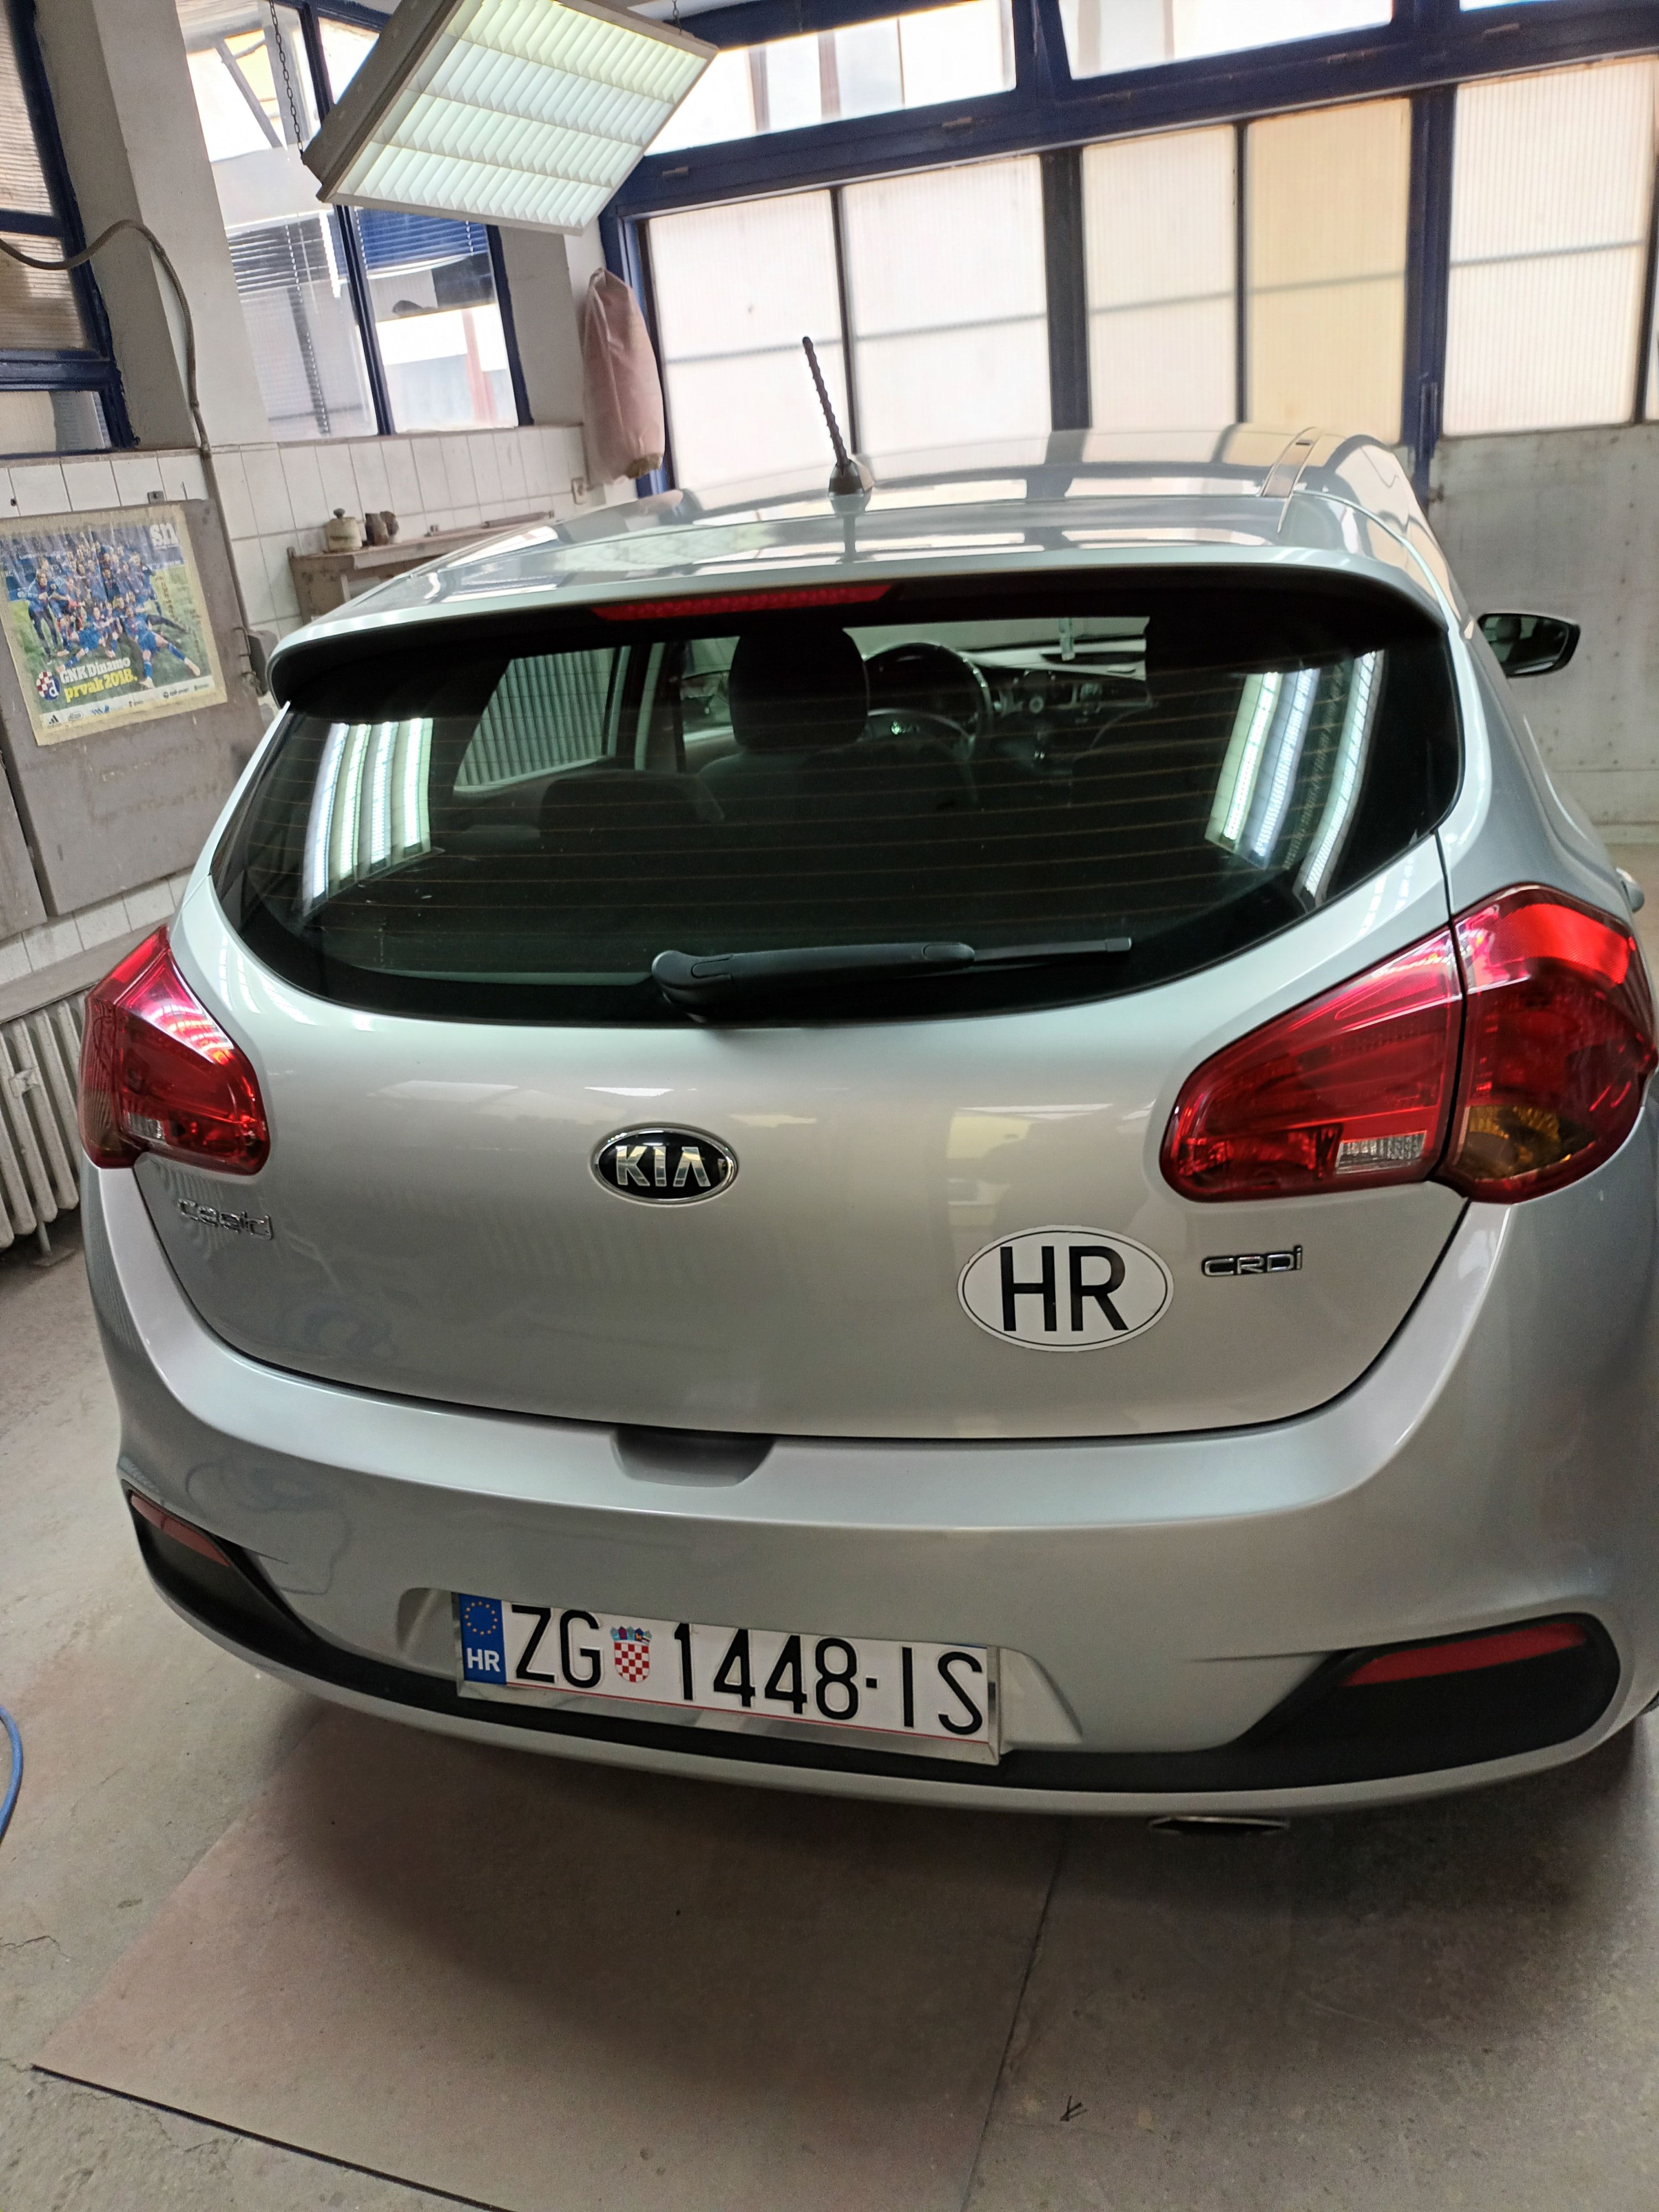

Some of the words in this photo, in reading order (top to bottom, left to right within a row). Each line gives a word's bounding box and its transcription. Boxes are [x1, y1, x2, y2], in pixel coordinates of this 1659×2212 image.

[60, 666, 88, 684] GNK
[87, 657, 131, 677] Dinamo
[64, 677, 104, 703] prvak
[103, 668, 138, 689] 2018.
[615, 1146, 711, 1187] KIA
[1202, 1245, 1303, 1277] CRDi
[1000, 1246, 1129, 1332] HR
[467, 1647, 501, 1672] HR
[511, 1604, 601, 1689] ZG
